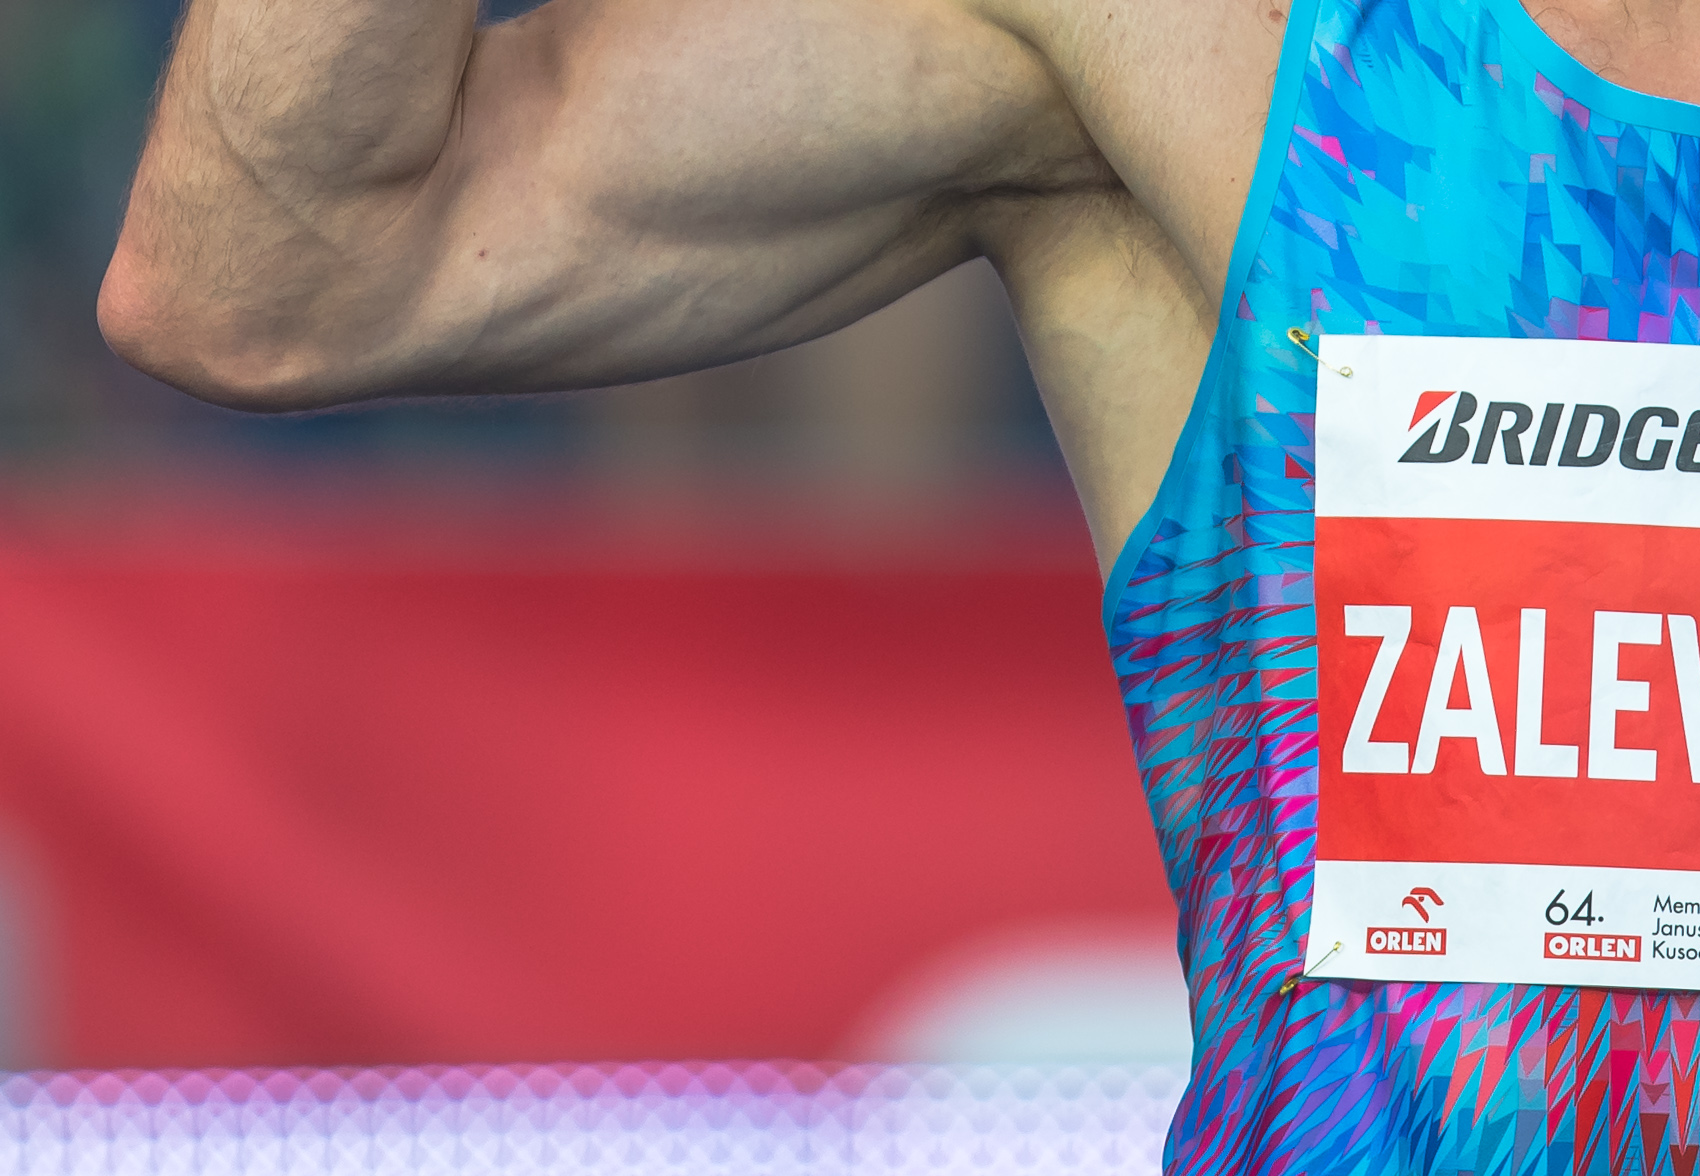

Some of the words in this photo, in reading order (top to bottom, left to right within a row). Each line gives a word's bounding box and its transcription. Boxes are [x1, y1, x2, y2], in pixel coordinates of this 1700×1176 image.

[1545, 889, 1604, 926] 64.
[1369, 930, 1442, 952] ORLEN
[1548, 936, 1636, 958] ORLEN
